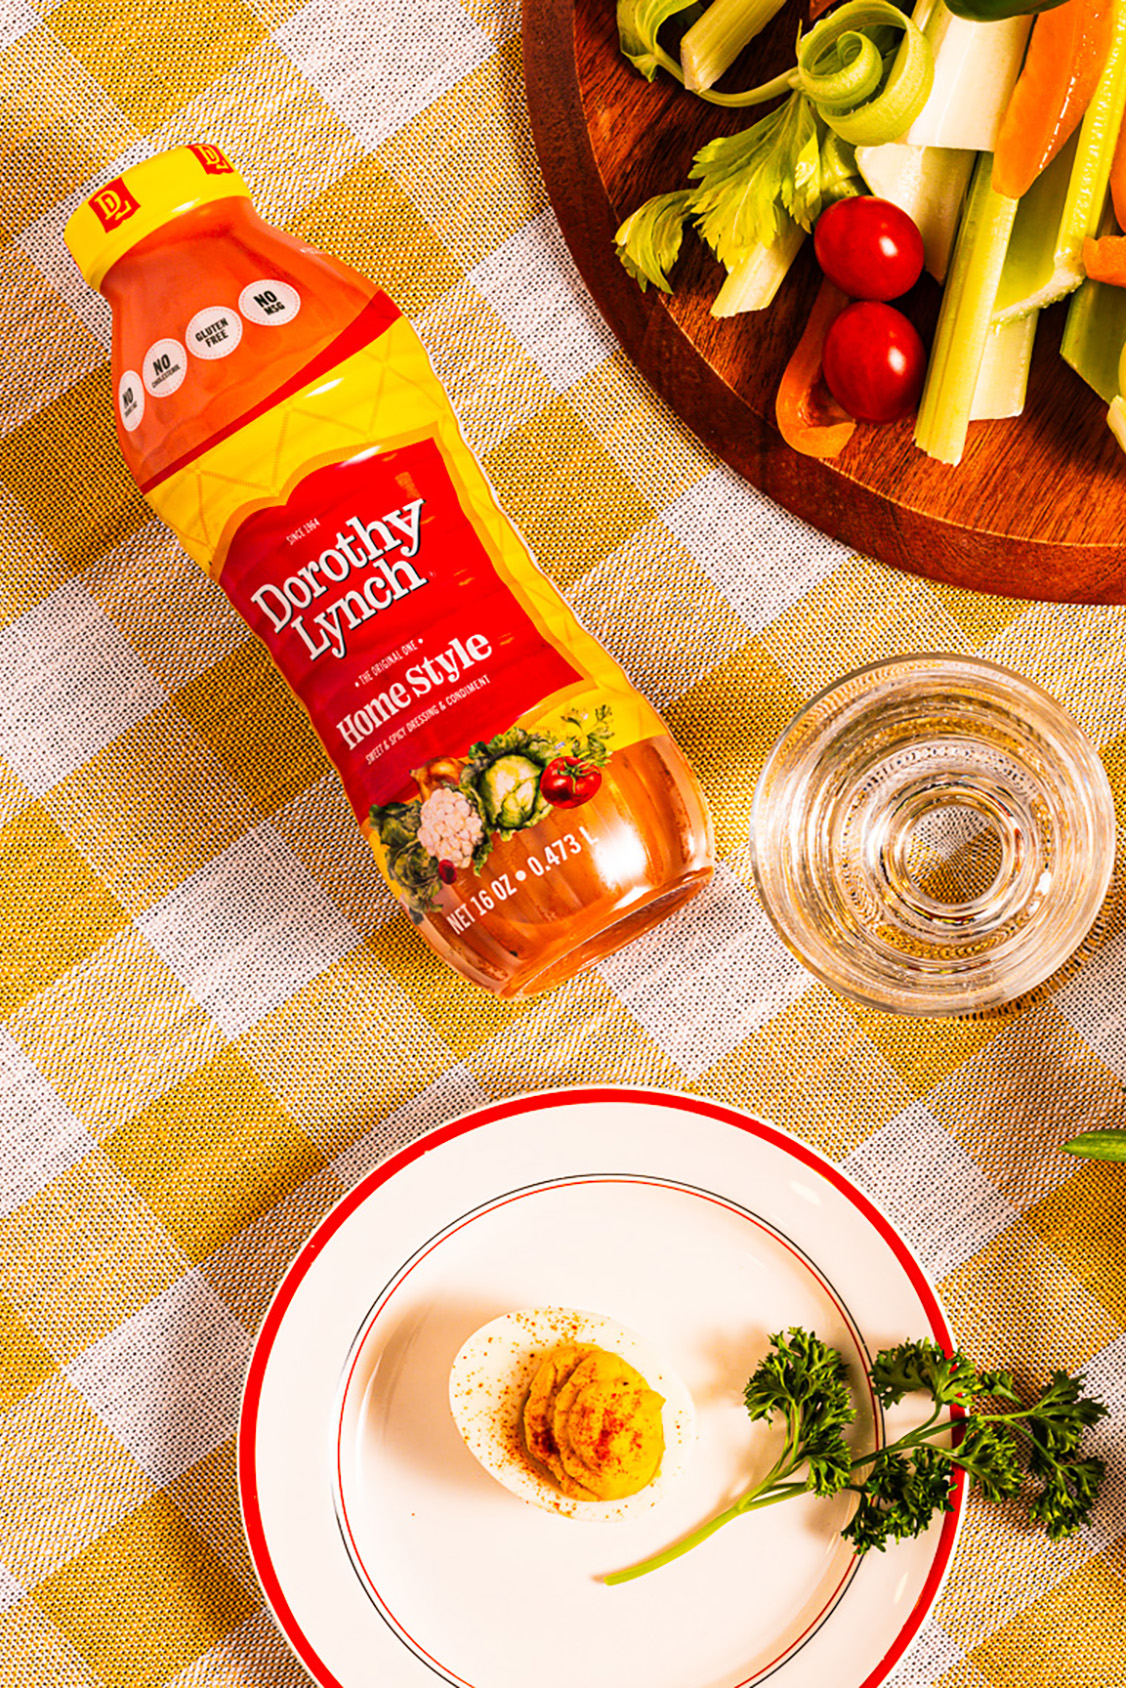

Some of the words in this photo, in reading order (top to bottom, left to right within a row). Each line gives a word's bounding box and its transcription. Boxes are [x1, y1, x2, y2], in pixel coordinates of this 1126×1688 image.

[94, 190, 132, 220] DL
[253, 290, 277, 307] NO
[263, 301, 285, 316] MSG
[195, 317, 229, 342] GLUTEN
[205, 330, 229, 348] FREE
[153, 353, 171, 376] NO
[122, 387, 134, 409] NO
[286, 528, 306, 546] SINCE
[303, 517, 320, 533] 1964
[251, 498, 426, 634] Dorothy
[291, 558, 429, 661] Lynch
[358, 671, 373, 685] THE
[371, 651, 403, 676] ORIGINAL
[401, 640, 418, 655] ONE
[336, 682, 411, 751] Home
[405, 634, 492, 698] Style
[365, 743, 385, 765] SWEET
[383, 740, 390, 751] &
[388, 727, 408, 746] SPICY
[406, 705, 440, 732] DRESSING
[439, 701, 447, 711] &
[445, 674, 491, 706] CONDIMENT
[446, 903, 476, 935] NET
[470, 889, 495, 916] 16
[491, 874, 518, 901] OZ
[527, 834, 582, 877] 0.473
[579, 826, 599, 845] L
